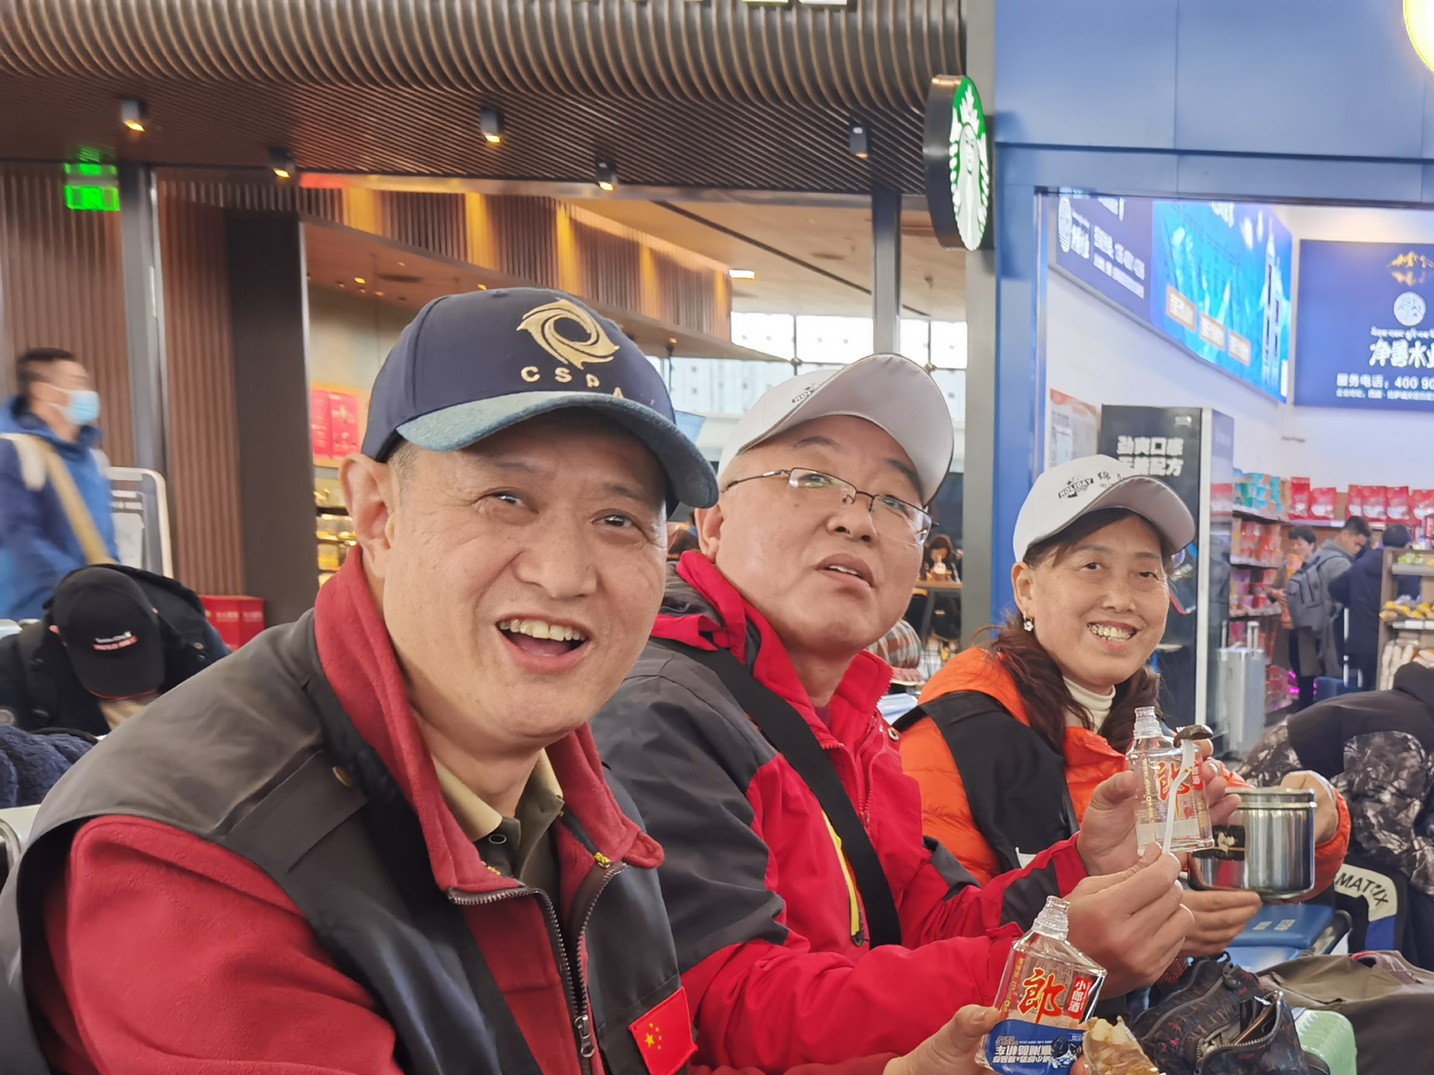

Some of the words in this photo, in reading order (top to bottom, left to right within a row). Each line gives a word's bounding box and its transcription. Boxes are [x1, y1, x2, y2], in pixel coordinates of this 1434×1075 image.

[1394, 376, 1419, 390] 400
[1017, 967, 1066, 1024] 郎
[1067, 980, 1087, 1013] 小郎酒
